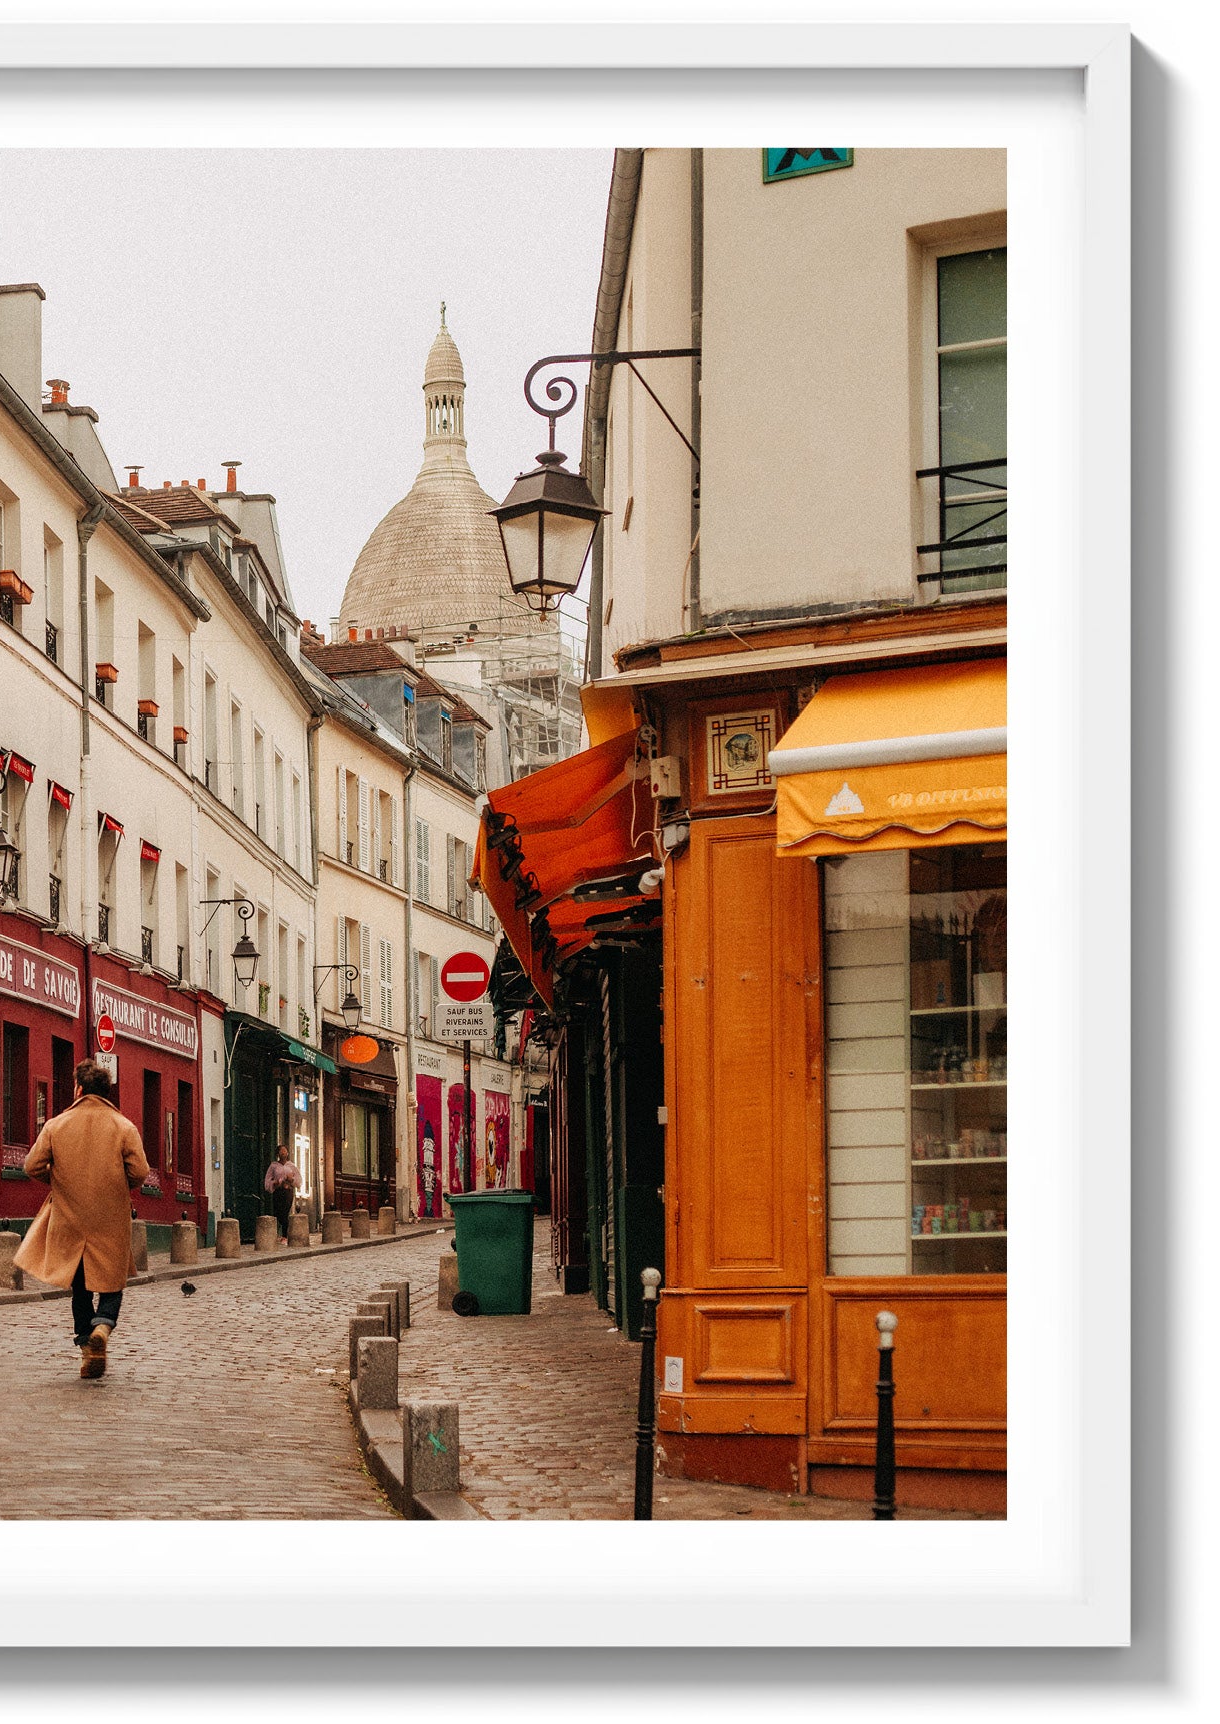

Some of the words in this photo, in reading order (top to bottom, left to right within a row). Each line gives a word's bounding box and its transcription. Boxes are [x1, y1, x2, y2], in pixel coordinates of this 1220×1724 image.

[23, 958, 36, 990] DE
[44, 967, 77, 1006] SAVOIE
[95, 991, 147, 1031] RESTAURANT
[148, 1011, 158, 1036] LE
[160, 1015, 194, 1049] CONSULAT
[446, 1018, 484, 1026] RIVERAINS
[453, 1028, 488, 1036] SERVICES
